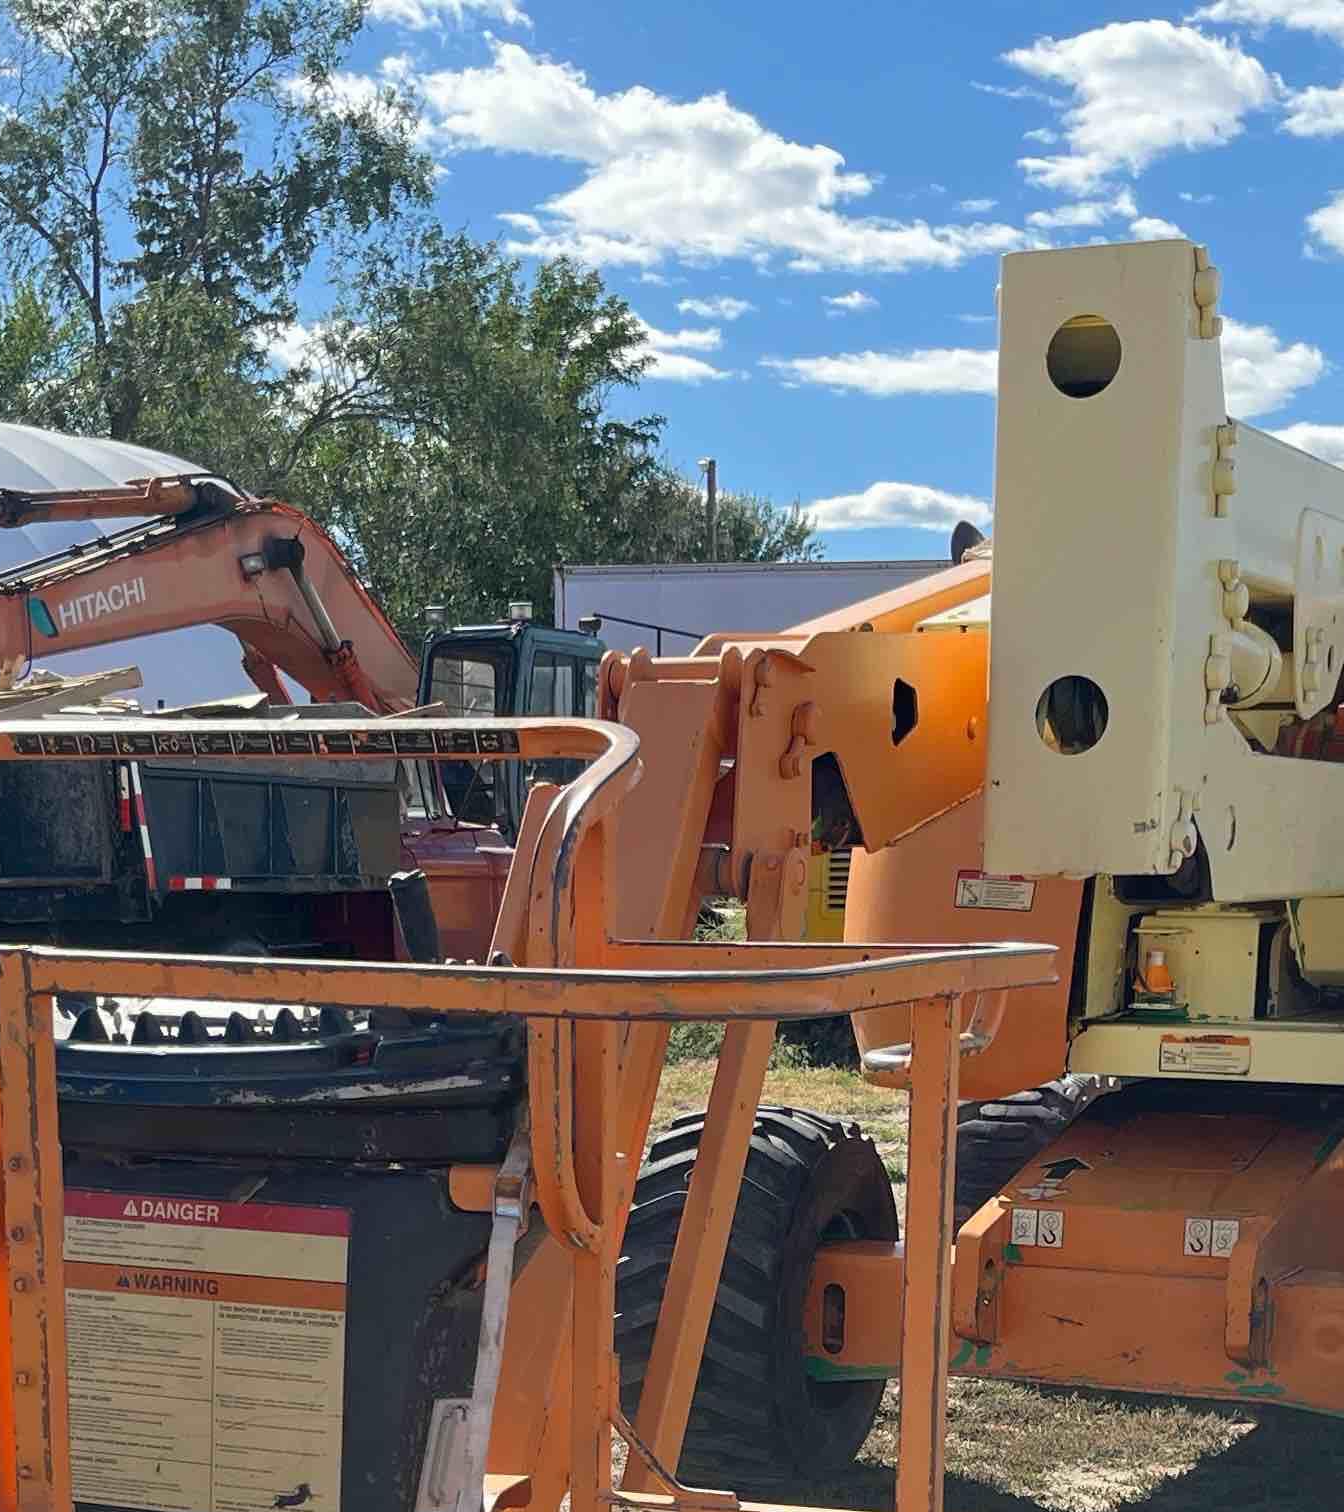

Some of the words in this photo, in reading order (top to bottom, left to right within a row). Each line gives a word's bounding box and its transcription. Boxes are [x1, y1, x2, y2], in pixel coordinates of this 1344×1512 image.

[58, 577, 146, 629] HITACHI
[141, 1200, 220, 1222] DANGER
[133, 1273, 219, 1295] WARNING
